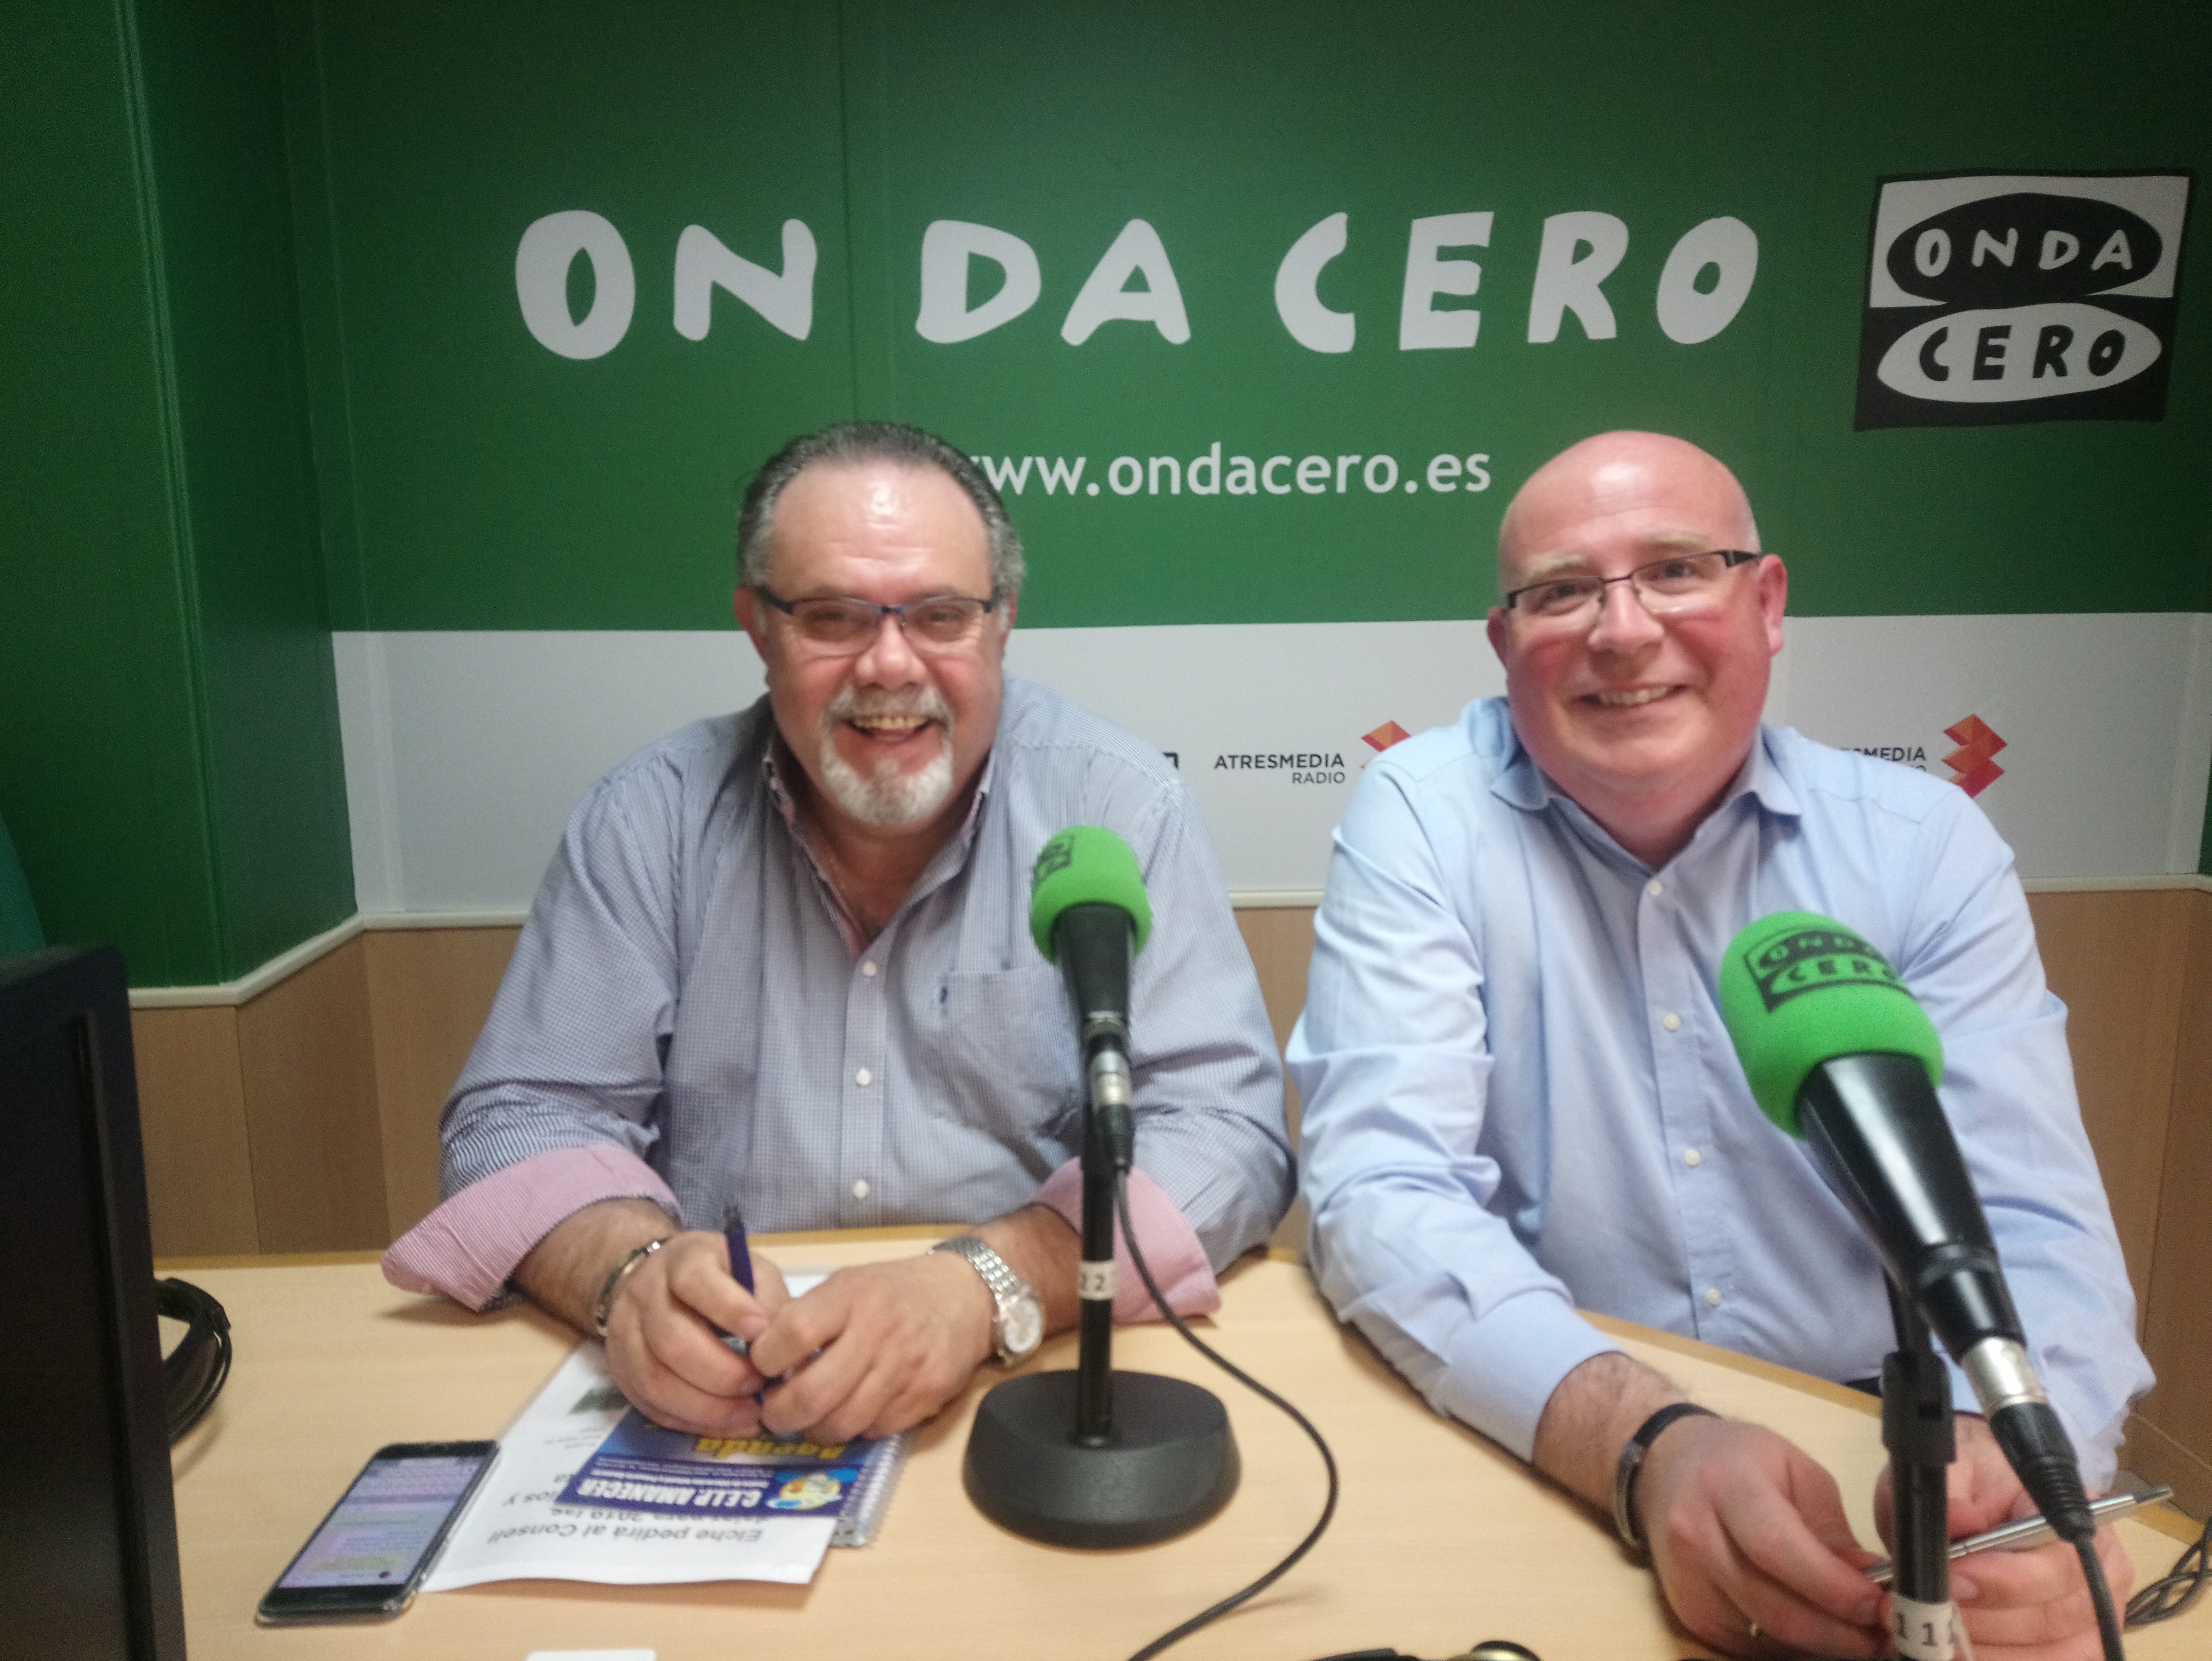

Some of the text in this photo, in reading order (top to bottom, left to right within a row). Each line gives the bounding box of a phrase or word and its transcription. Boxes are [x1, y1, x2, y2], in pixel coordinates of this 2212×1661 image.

[1915, 227, 2133, 277] ONDA
[1274, 211, 1758, 354] CERO
[1919, 324, 2125, 382] CERO
[969, 442, 1491, 497] ww.ondacero.es
[1214, 754, 1345, 770] ATRESMEDIA
[1292, 772, 1346, 784] RADIO
[577, 1479, 696, 1506] AMANECER
[486, 1524, 577, 1544] Consell
[695, 1528, 763, 1542] Elche
